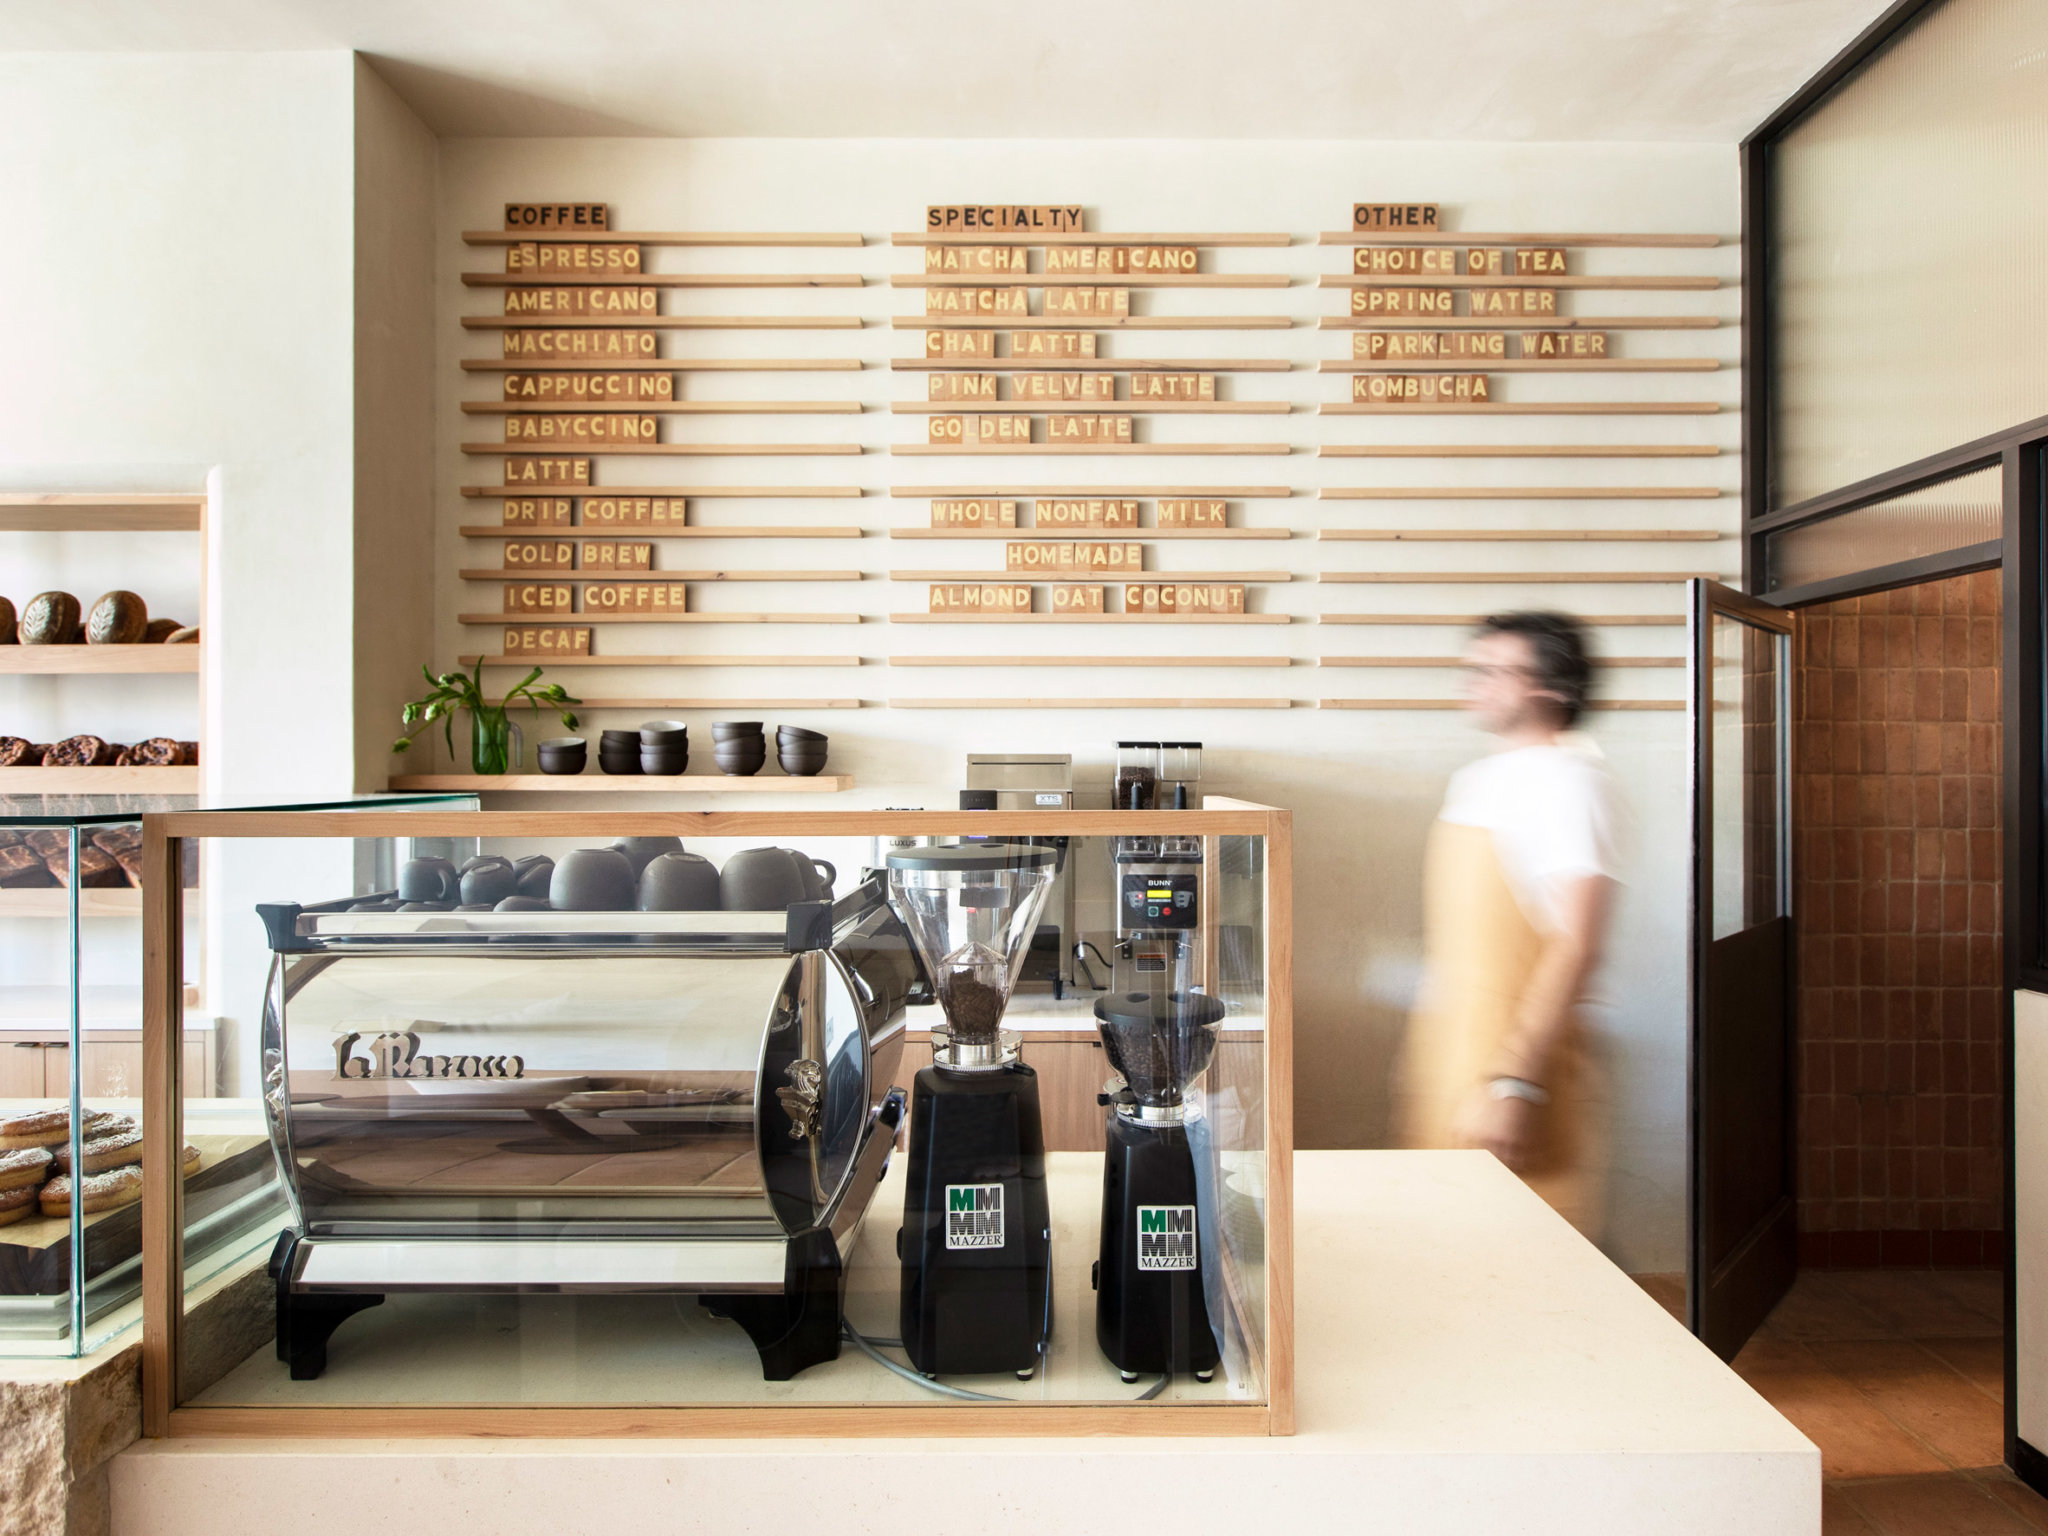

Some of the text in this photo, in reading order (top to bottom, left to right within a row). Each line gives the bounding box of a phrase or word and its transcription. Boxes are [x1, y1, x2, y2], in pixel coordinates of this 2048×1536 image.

[506, 206, 605, 225] COFFEE
[929, 207, 1080, 226] SPECIALTY
[1354, 206, 1437, 226] OTHER
[508, 246, 640, 268] ESPRESSO
[926, 248, 1197, 269] MATCHA AMERICANO
[1355, 249, 1566, 271] CHOICE OF TEA
[505, 290, 656, 310] AMERICANO
[927, 289, 1128, 311] MATCHA LATTE
[1352, 291, 1554, 312] SPRING WATER
[504, 333, 656, 353] MACCHIATO
[926, 332, 1094, 353] CHAI LATTE
[1354, 335, 1605, 354] SPARKLING WATER
[504, 375, 672, 396] CAPPUCCINO
[930, 376, 1213, 395] PINK VELVET LATTE
[1354, 376, 1487, 397] KOMBUCHA
[506, 416, 656, 437] BABYCCINO
[930, 417, 1130, 438] GOLDEN LATTE
[506, 460, 588, 480] LATTE
[504, 500, 684, 520] DRIP COFFEE
[931, 502, 1224, 522] WHOLE NONFAT MILK
[505, 544, 650, 564] COLD BREW
[1008, 545, 1140, 565] HOMEMADE
[509, 586, 683, 606] ICED COFFEE
[931, 586, 1242, 607] ALMOND OAT COCONUT
[505, 629, 588, 649] DECAF
[949, 1234, 1002, 1247] MAZZER
[1141, 1257, 1194, 1269] MAZZER
